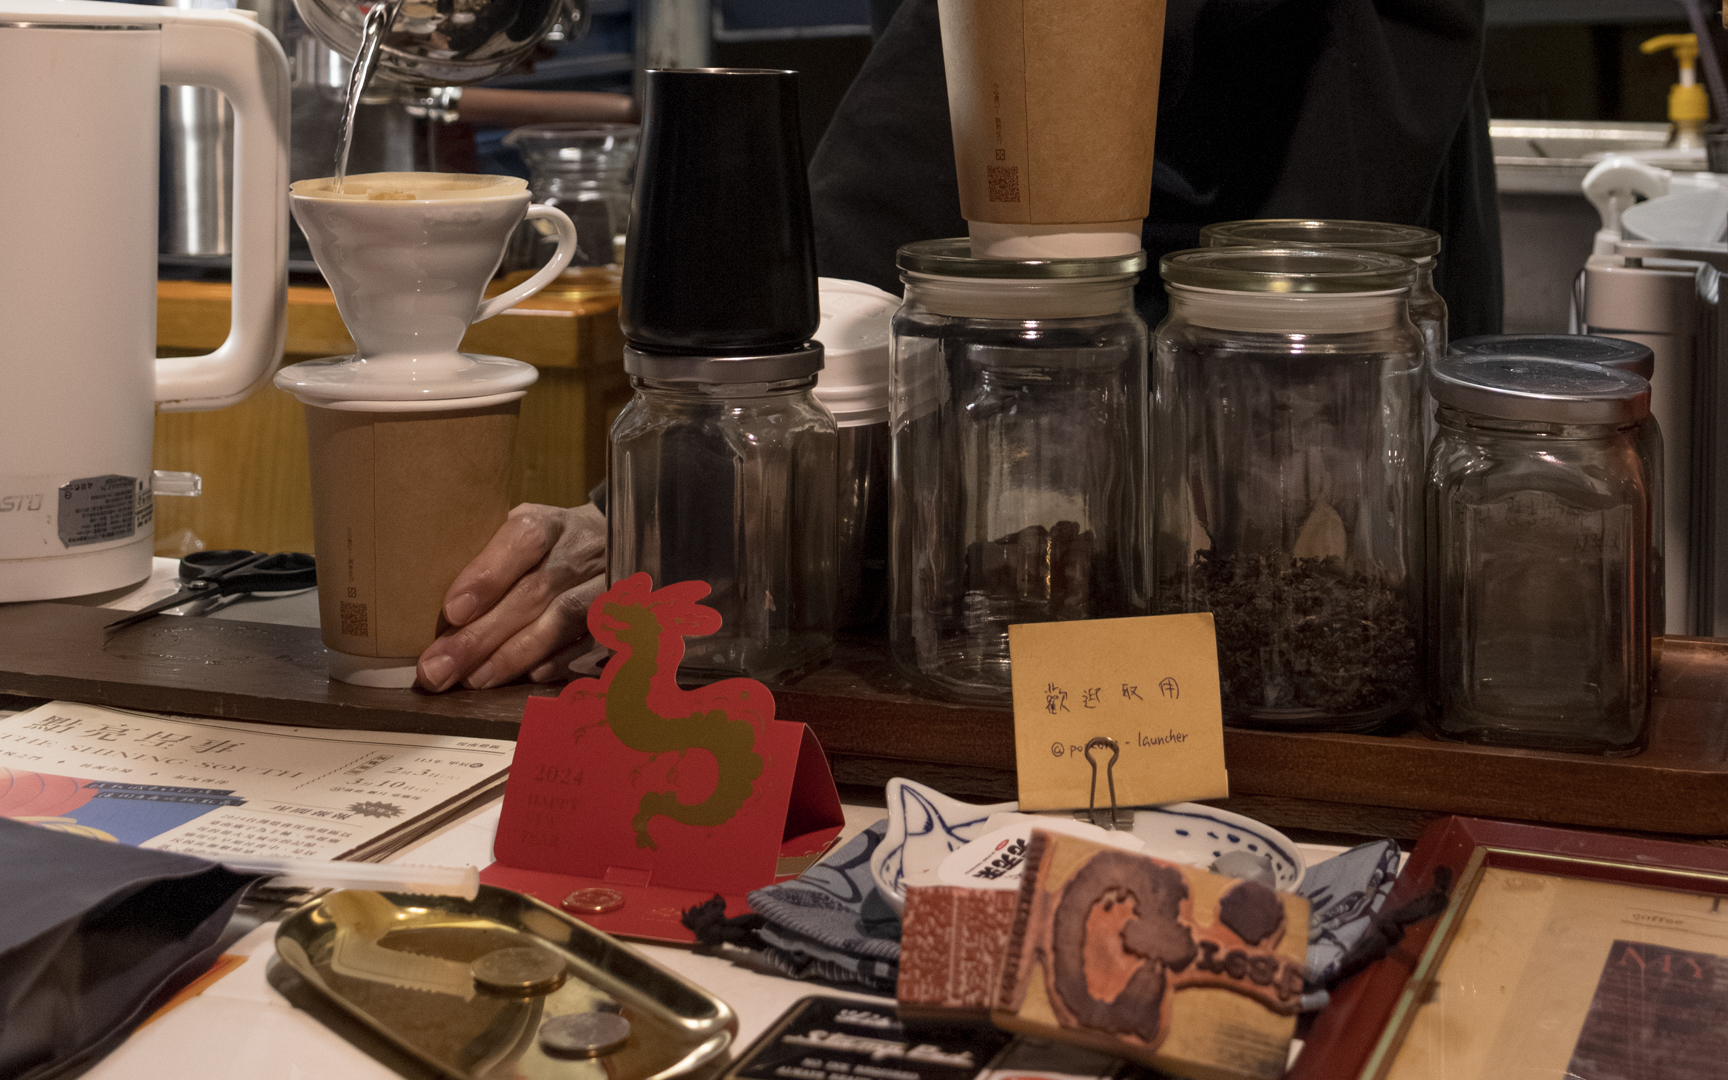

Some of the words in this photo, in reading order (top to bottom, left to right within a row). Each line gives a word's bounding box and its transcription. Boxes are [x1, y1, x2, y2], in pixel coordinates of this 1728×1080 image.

[1045, 677, 1180, 715] 歡迎取用
[63, 743, 190, 766] SHINING
[533, 764, 584, 786] 2024
